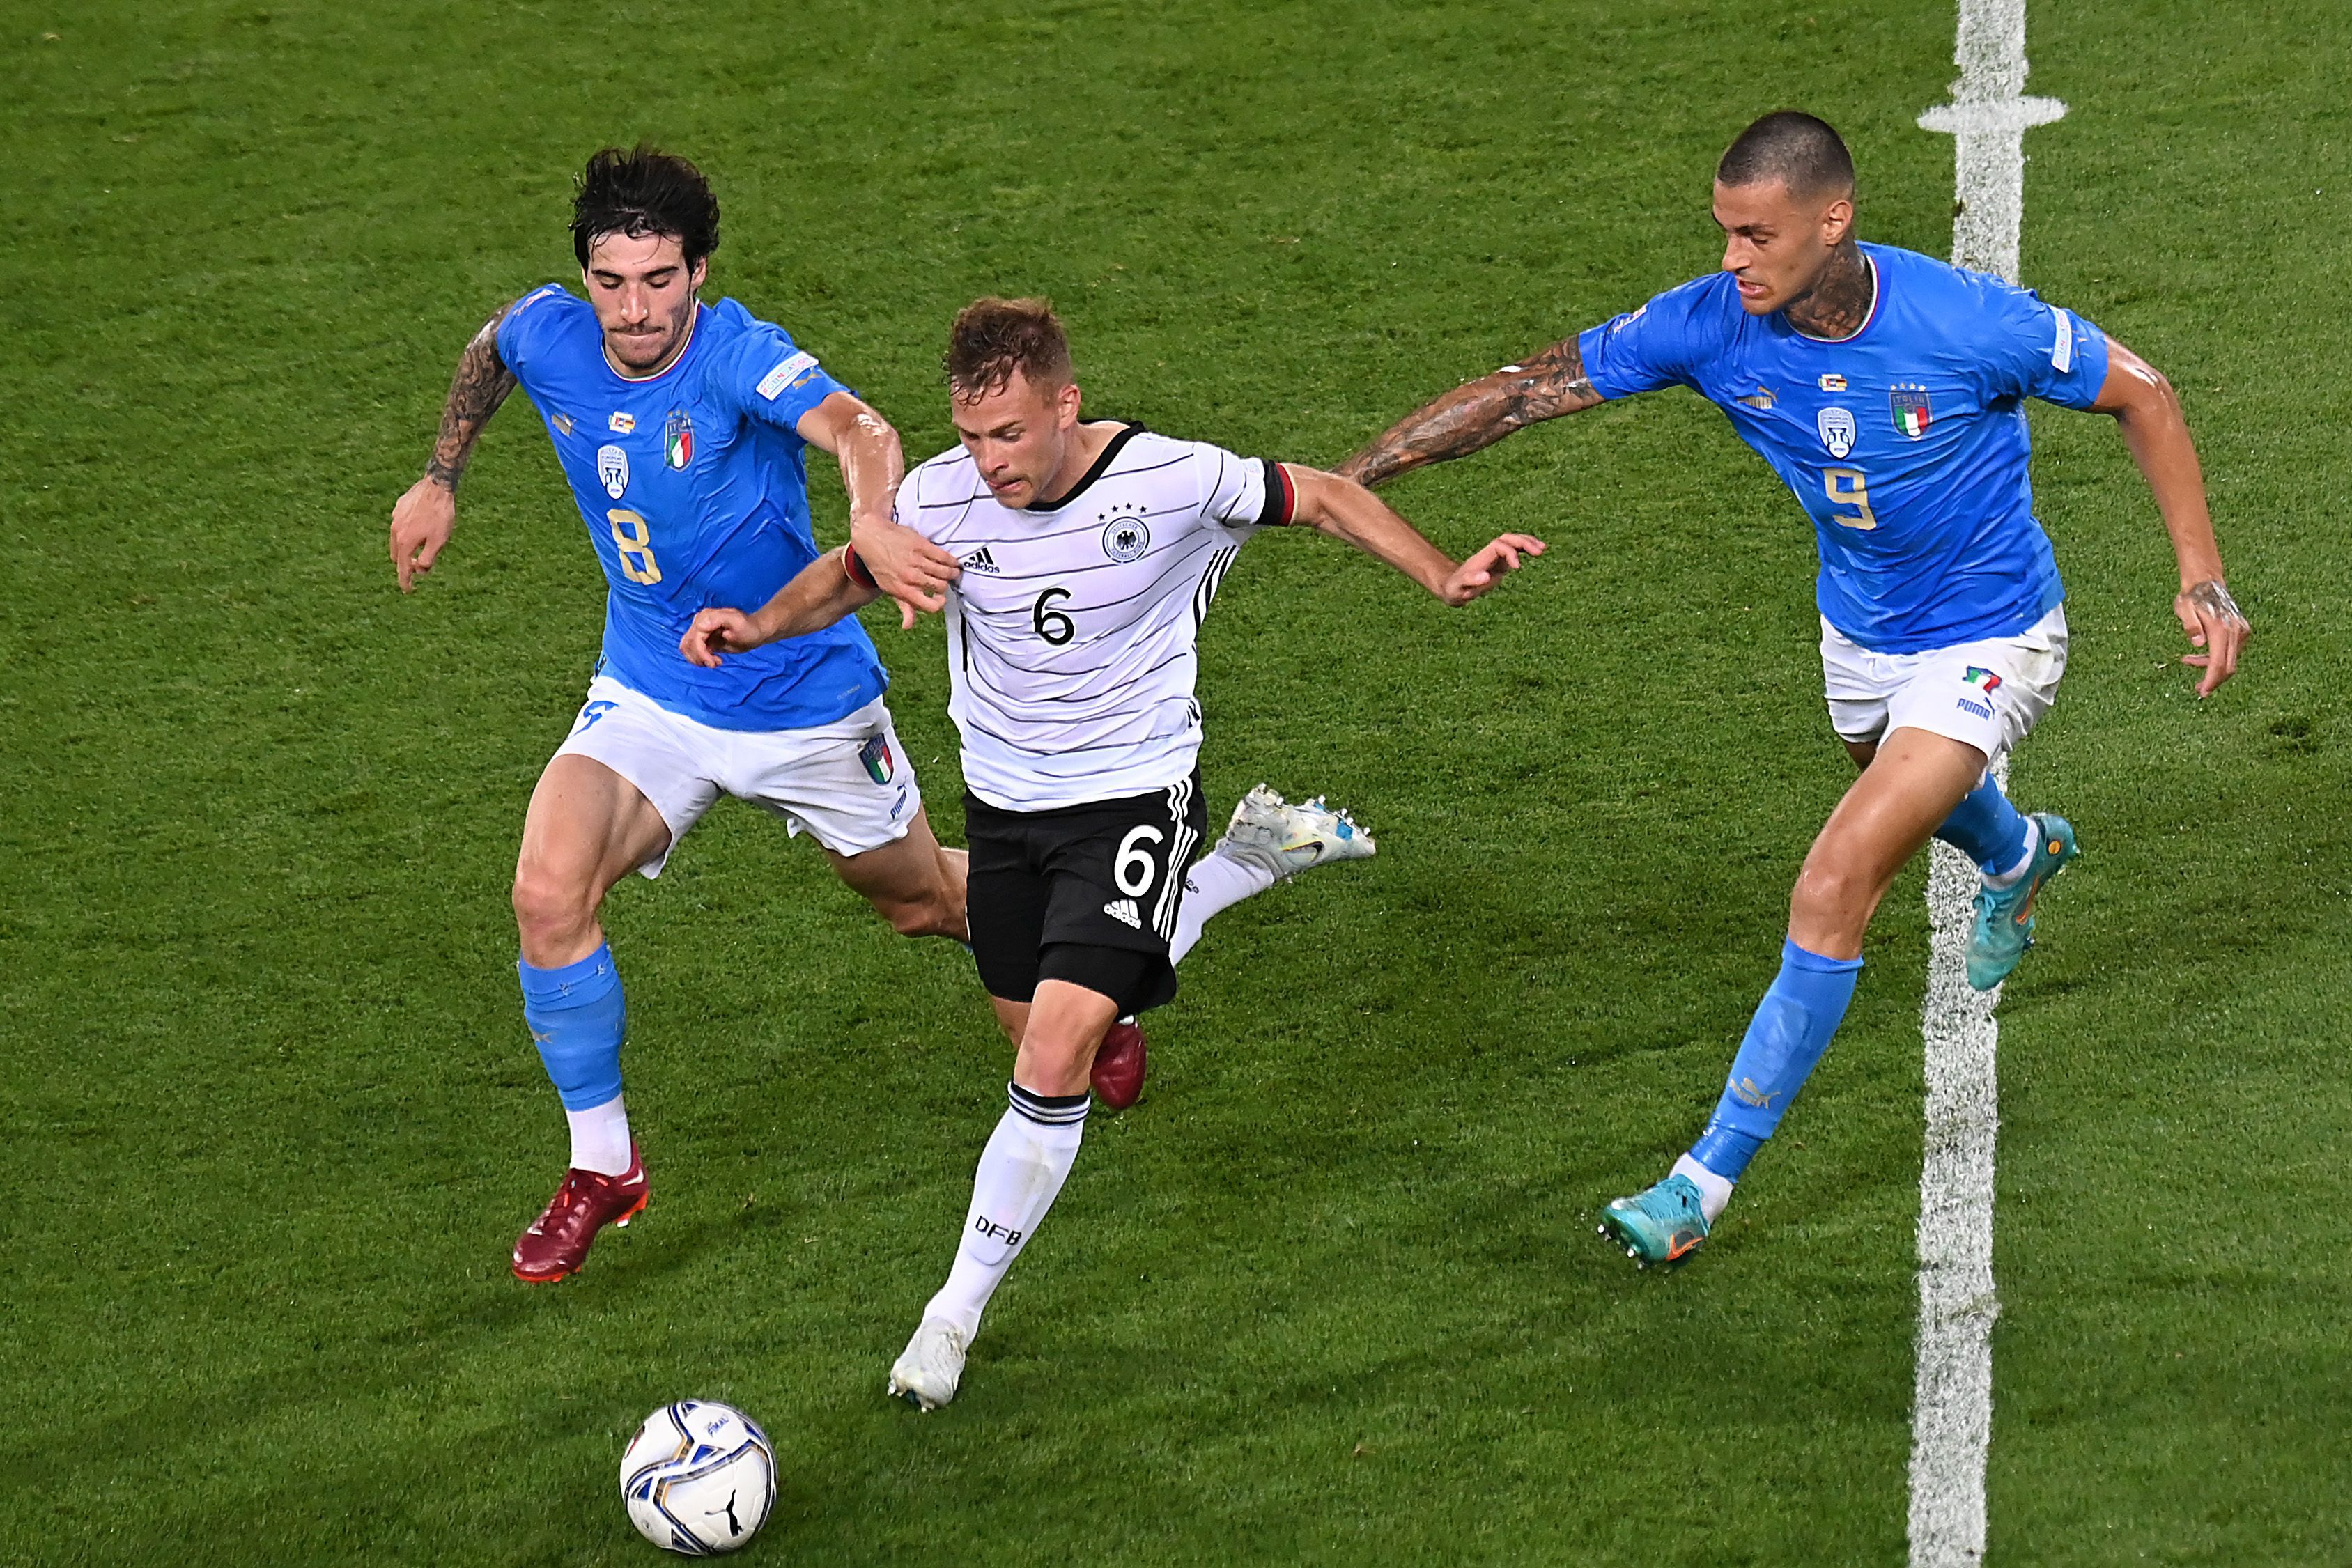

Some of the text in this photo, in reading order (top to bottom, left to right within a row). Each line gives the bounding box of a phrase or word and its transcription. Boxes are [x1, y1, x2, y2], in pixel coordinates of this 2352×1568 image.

[1822, 468, 1877, 530] 9
[606, 509, 662, 585] 8
[964, 561, 1000, 573] adidas
[1033, 588, 1074, 646] 6
[1956, 698, 1990, 720] PUMA
[890, 789, 907, 820] PUMA
[1115, 825, 1163, 897] 6
[1104, 903, 1142, 929] adidas
[975, 1216, 1021, 1245] DFB
